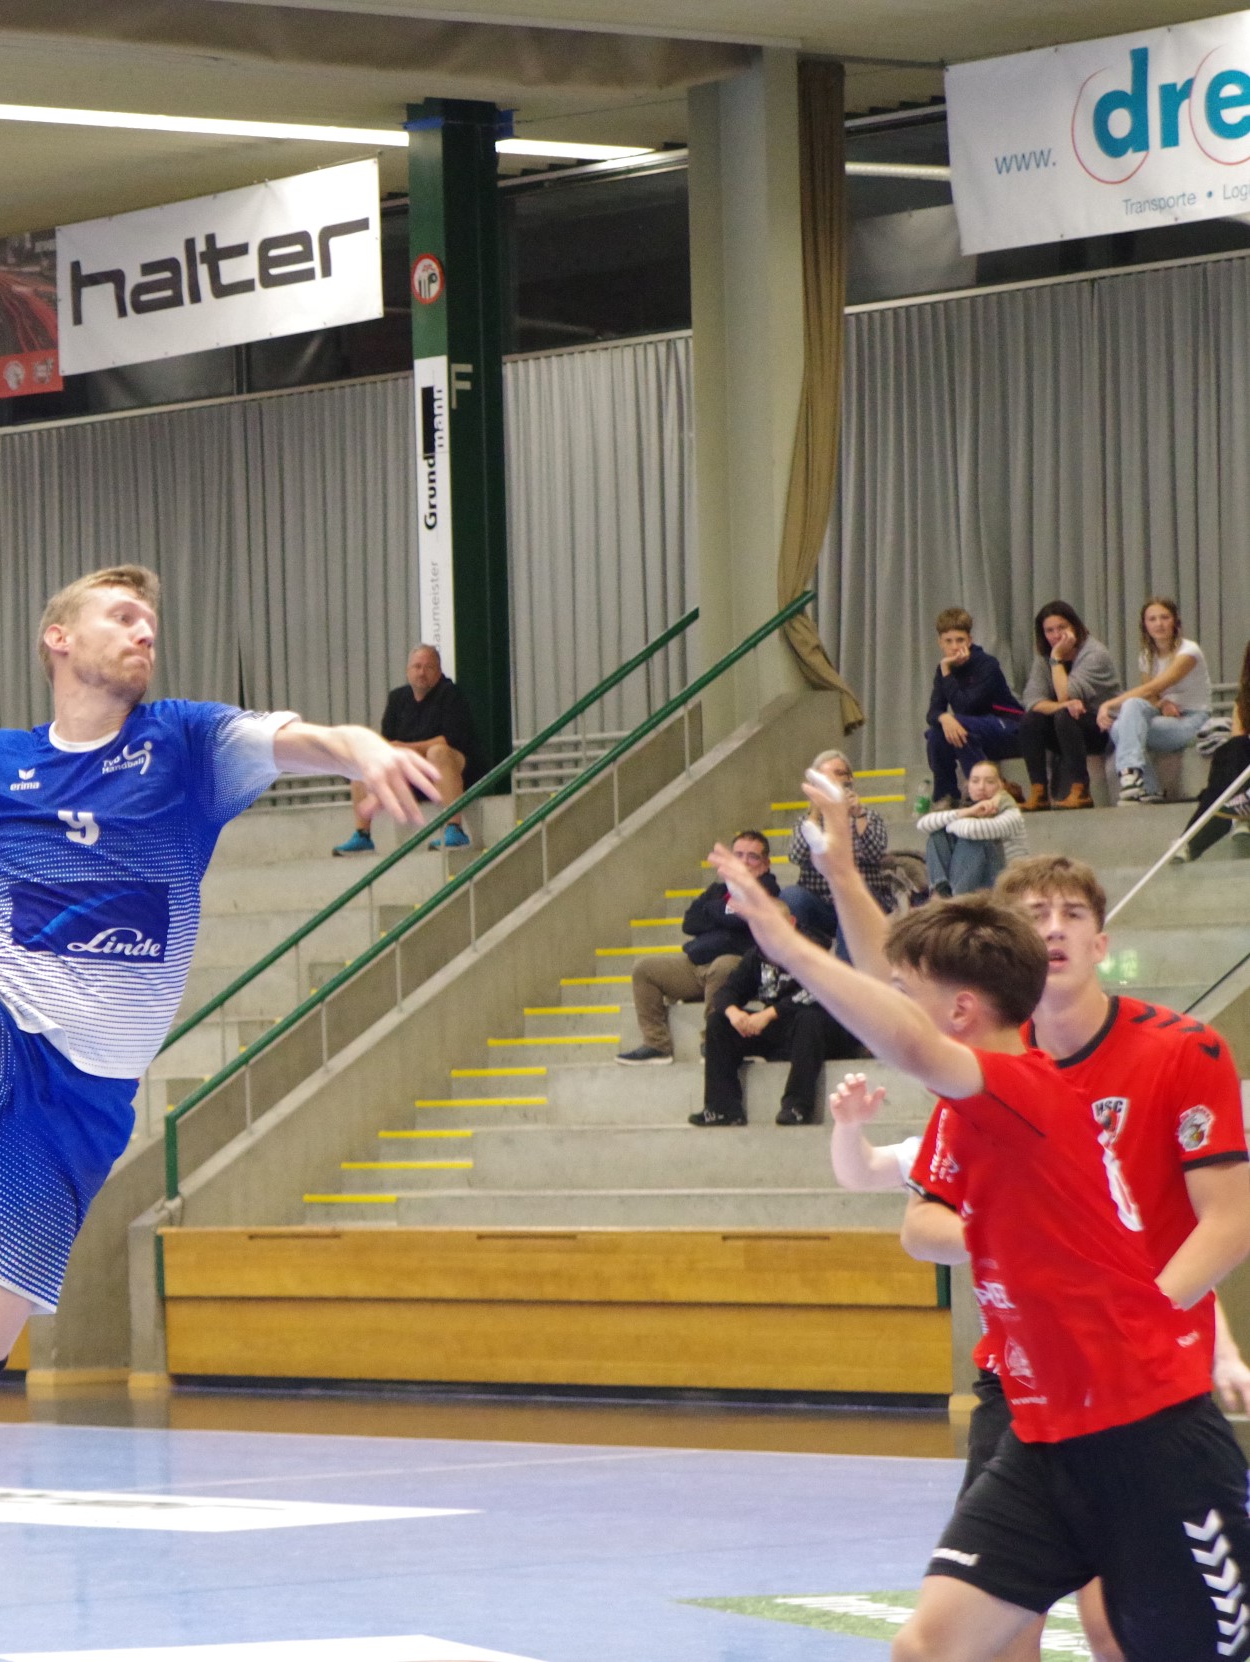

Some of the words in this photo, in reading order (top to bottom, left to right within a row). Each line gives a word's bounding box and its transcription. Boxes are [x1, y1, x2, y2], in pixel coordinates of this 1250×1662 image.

[994, 148, 1056, 175] www.
[1093, 46, 1250, 158] dre
[1123, 191, 1197, 216] Transporte
[1223, 183, 1250, 202] Log
[70, 217, 370, 326] halter
[451, 364, 473, 410] F
[10, 781, 40, 791] erima
[67, 927, 162, 957] Linde
[1095, 1100, 1123, 1117] HSC
